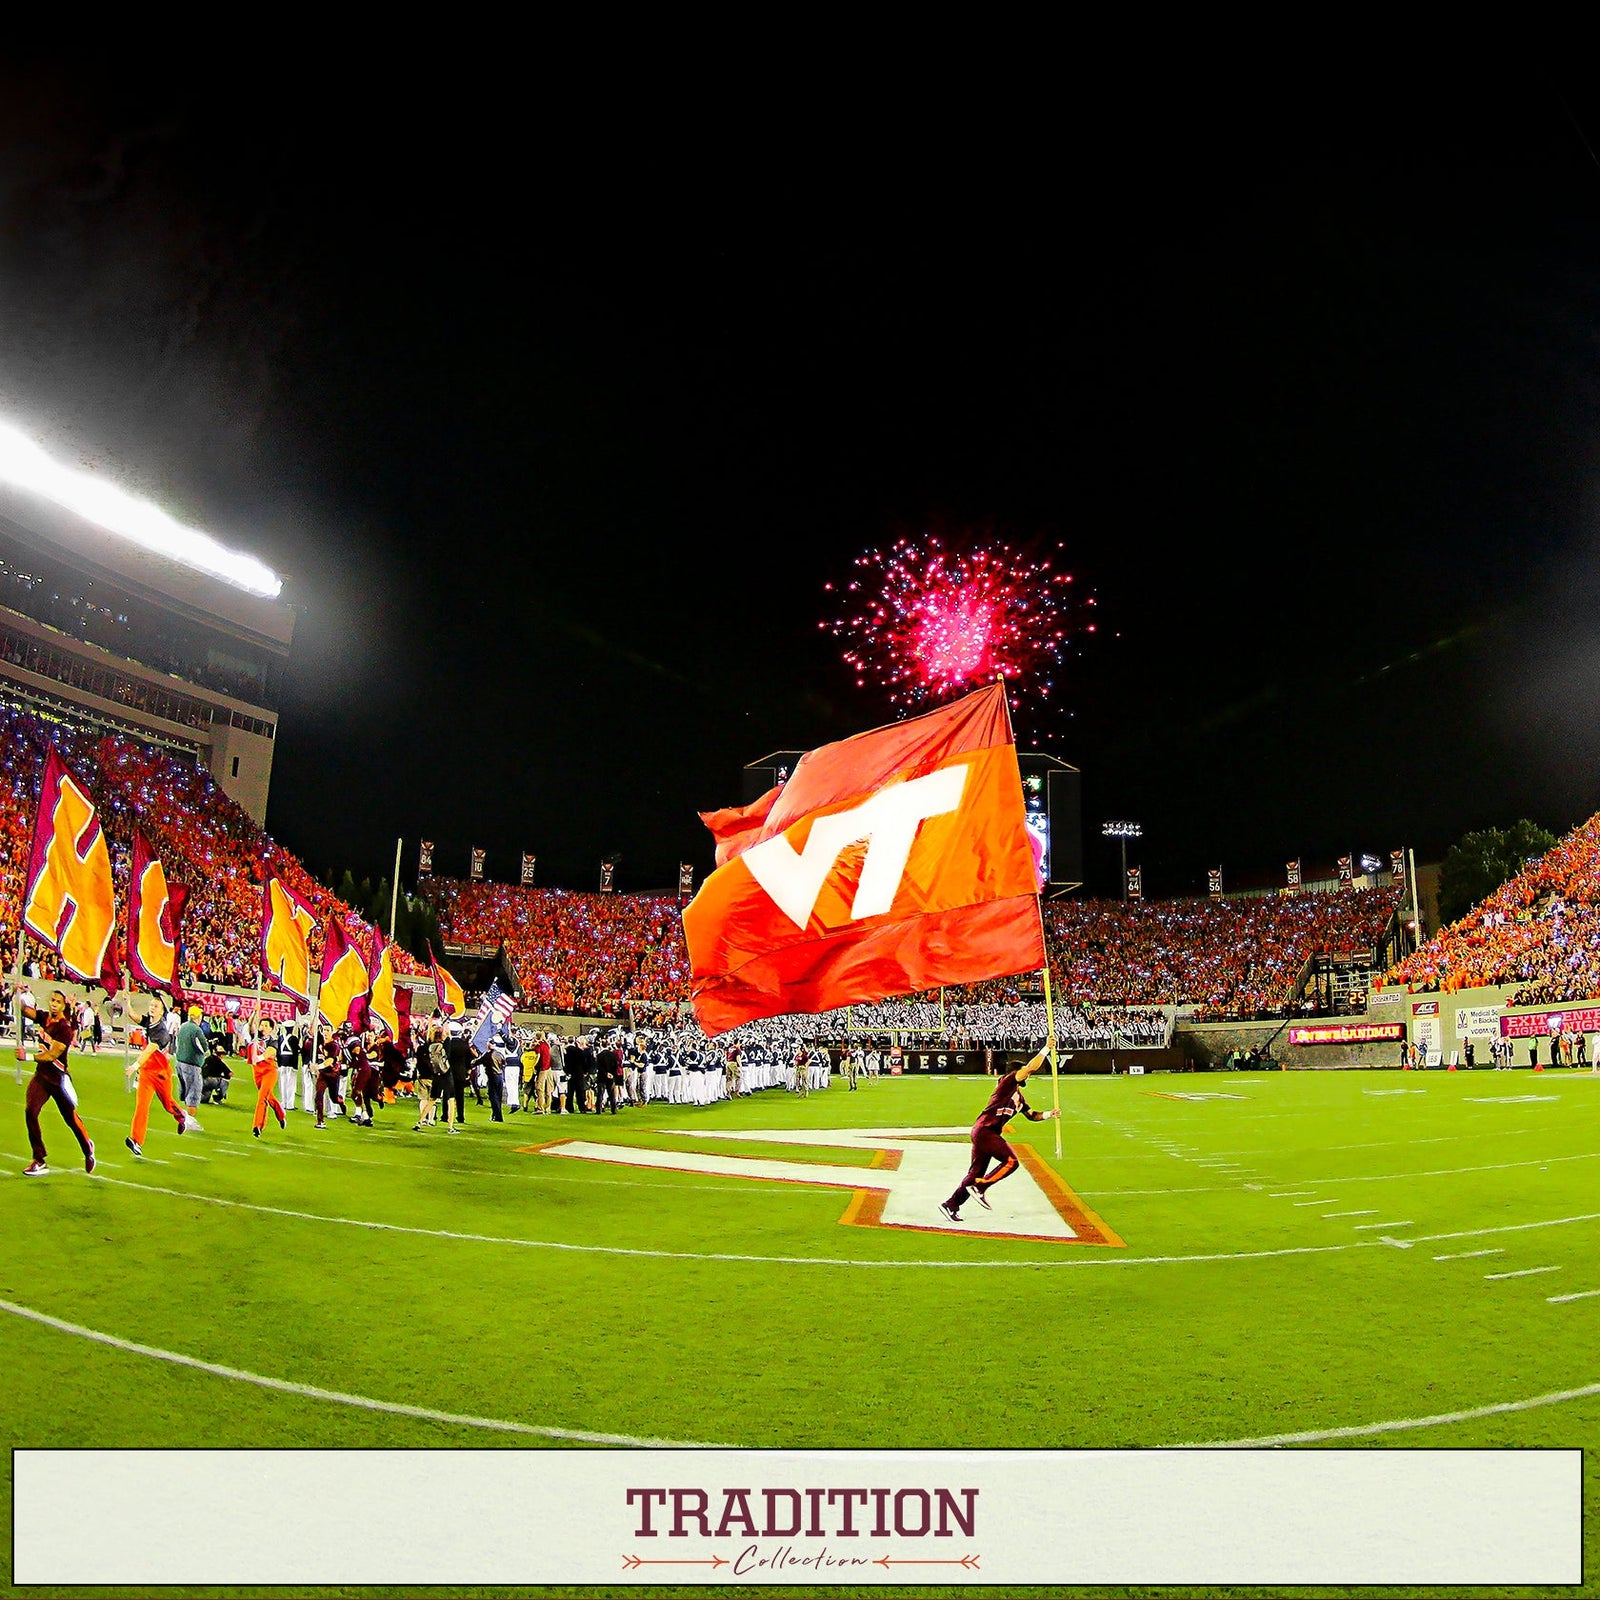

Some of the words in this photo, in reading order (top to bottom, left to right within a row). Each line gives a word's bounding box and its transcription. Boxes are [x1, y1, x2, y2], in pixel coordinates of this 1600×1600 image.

[741, 763, 969, 931] VT
[474, 862, 483, 873] 10
[523, 867, 534, 878] 25
[1391, 863, 1403, 874] 78
[1287, 873, 1299, 884] 58
[1339, 869, 1351, 880] 73
[604, 876, 611, 886] 7
[1128, 880, 1139, 891] 64
[1209, 882, 1220, 892] 56
[1349, 991, 1365, 1005] 25
[1415, 1002, 1436, 1014] ACC
[1507, 1014, 1547, 1028] EXIT
[1341, 1026, 1400, 1039] SANDMAN
[1508, 1026, 1547, 1037] LIGHT
